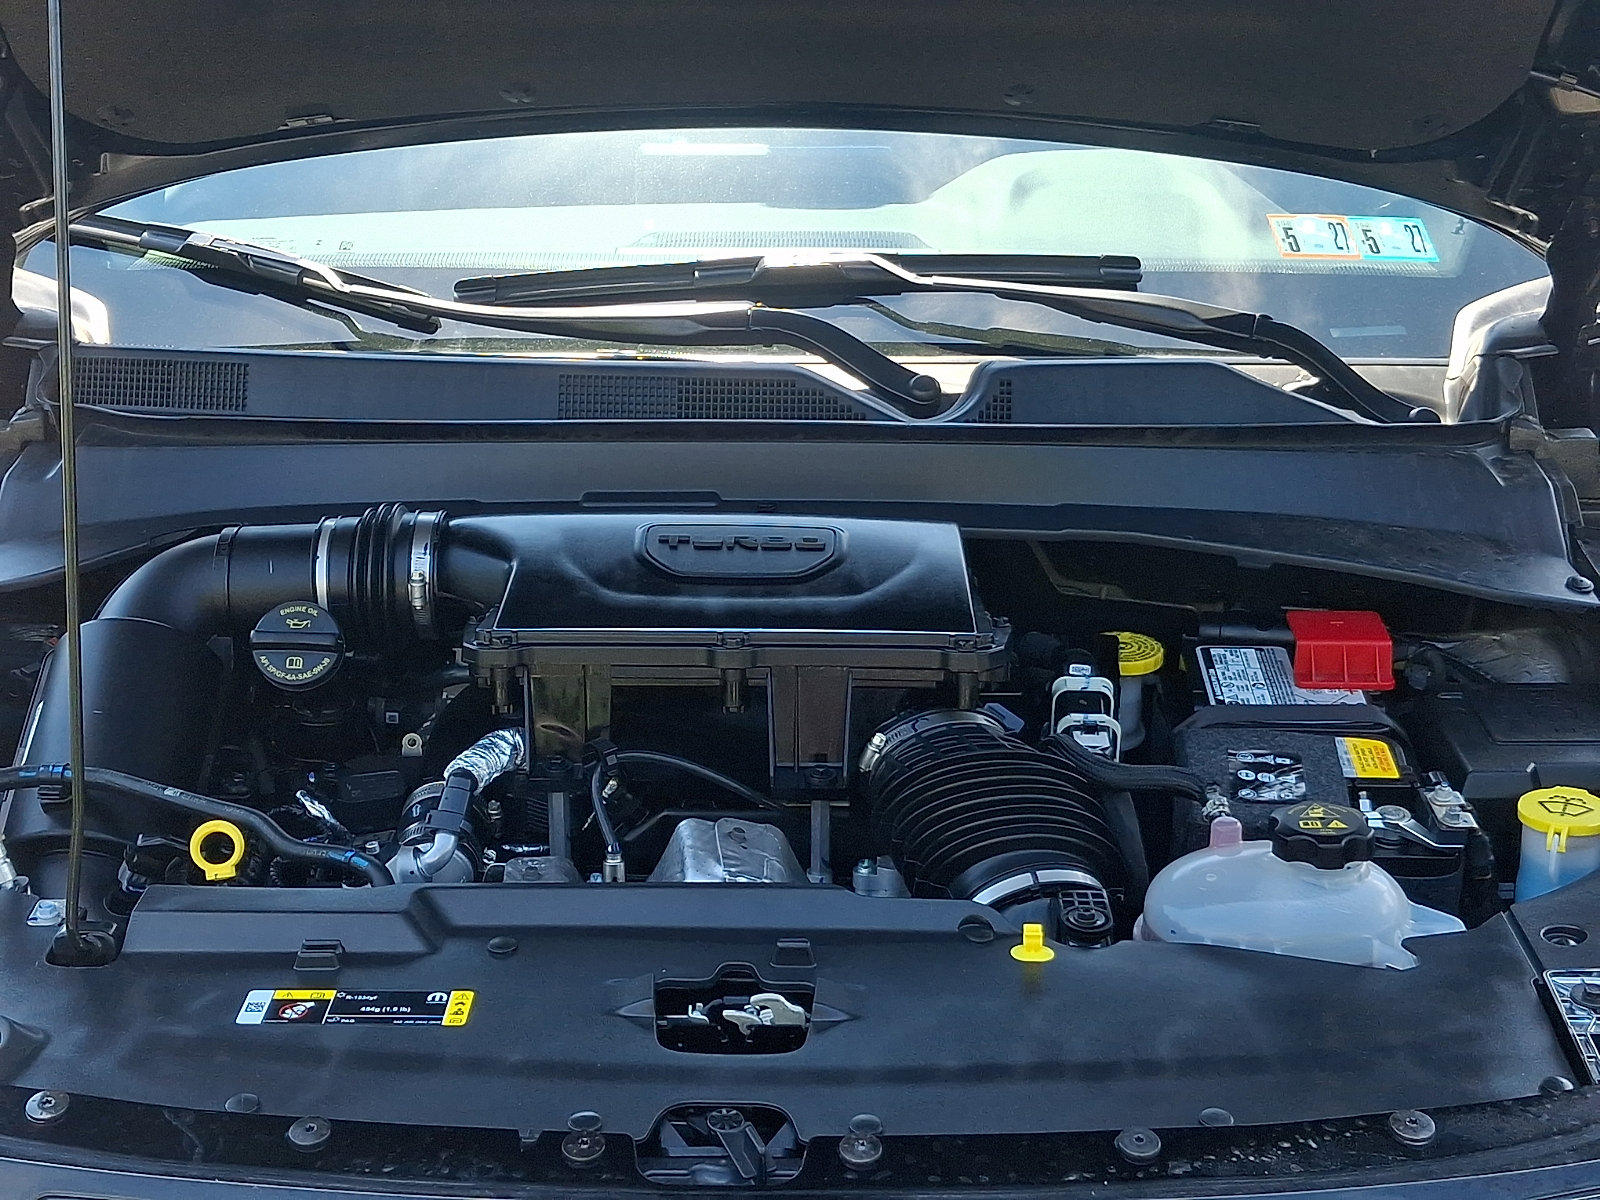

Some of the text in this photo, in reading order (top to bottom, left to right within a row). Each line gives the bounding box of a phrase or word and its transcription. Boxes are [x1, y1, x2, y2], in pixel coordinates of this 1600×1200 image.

[1282, 222, 1350, 253] 5 27
[1362, 224, 1428, 255] 5 27
[658, 534, 826, 551] TURBO
[280, 605, 319, 617] ENGINE OIL
[259, 655, 269, 667] API
